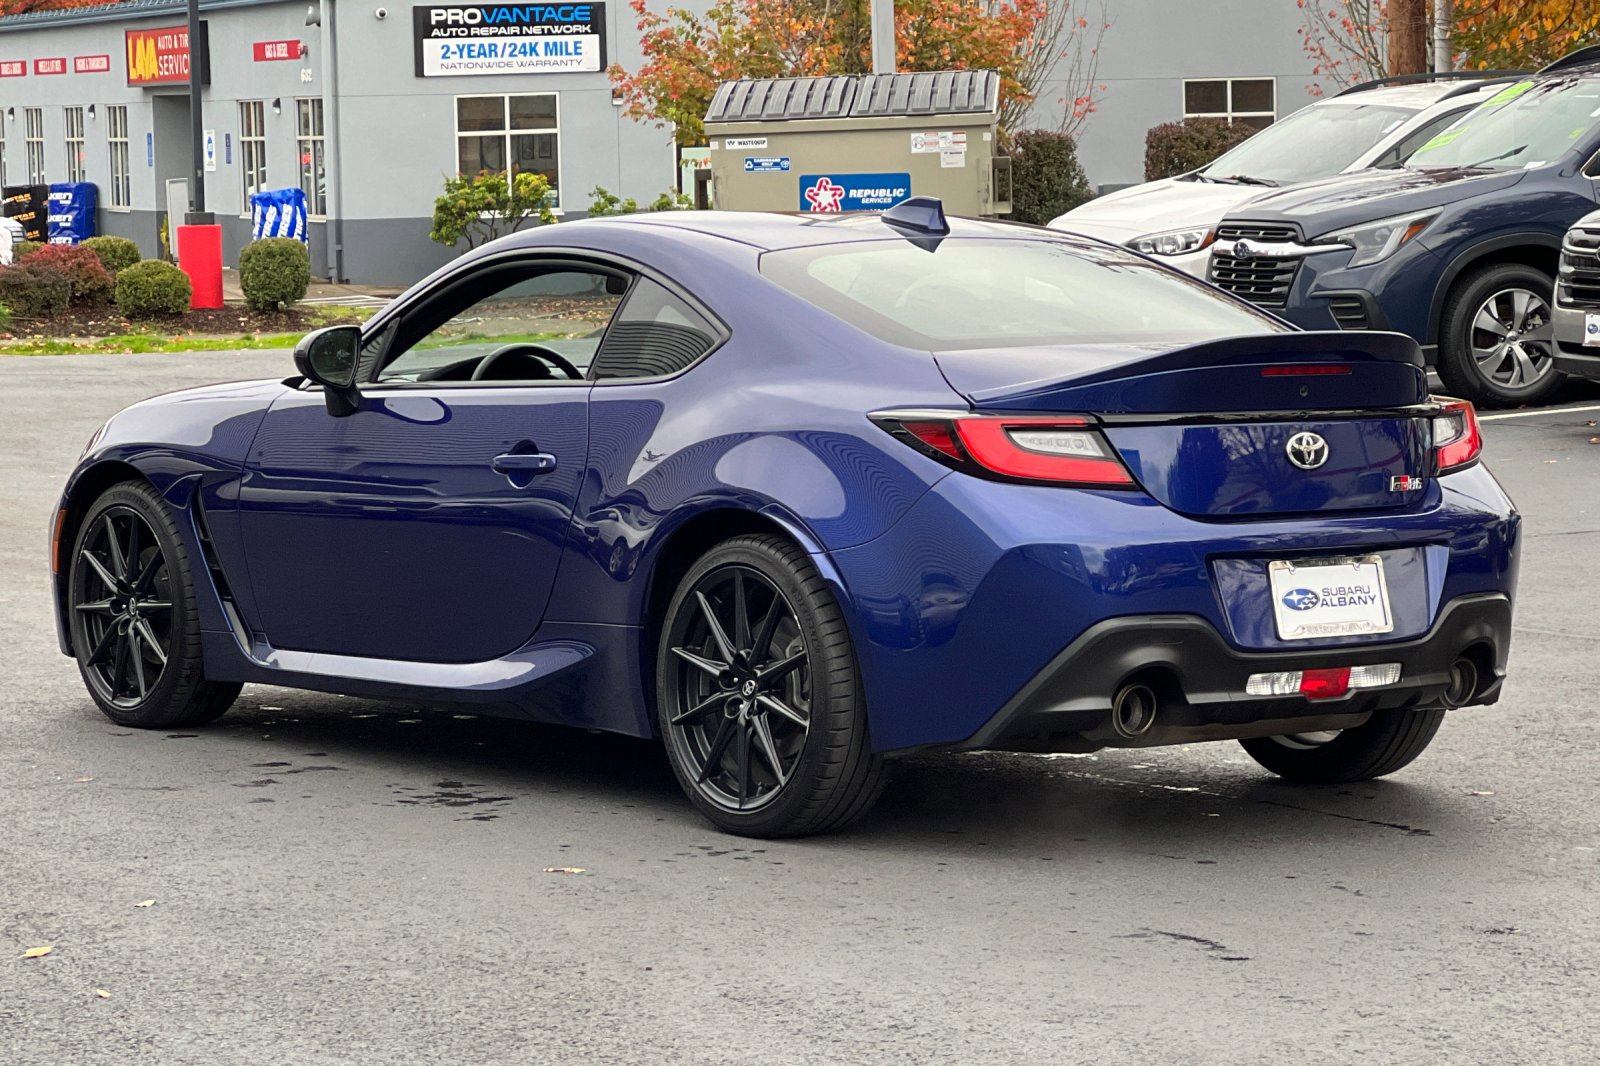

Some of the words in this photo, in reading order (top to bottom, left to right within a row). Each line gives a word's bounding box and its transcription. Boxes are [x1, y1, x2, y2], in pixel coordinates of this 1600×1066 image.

[431, 27, 468, 37] AUTO
[470, 26, 521, 36] REPAIR
[522, 24, 592, 35] NETWORK
[158, 34, 173, 50] AUTO
[173, 34, 179, 48] &
[179, 33, 189, 48] TIR
[544, 41, 583, 56] MILE
[158, 54, 190, 76] SERVIC
[440, 61, 514, 70] NATIONWIDE
[516, 59, 583, 68] WARRANTY
[849, 188, 905, 198] REPUBLIC
[1321, 585, 1371, 597] SUBARU
[1320, 595, 1376, 608] ALBANY
